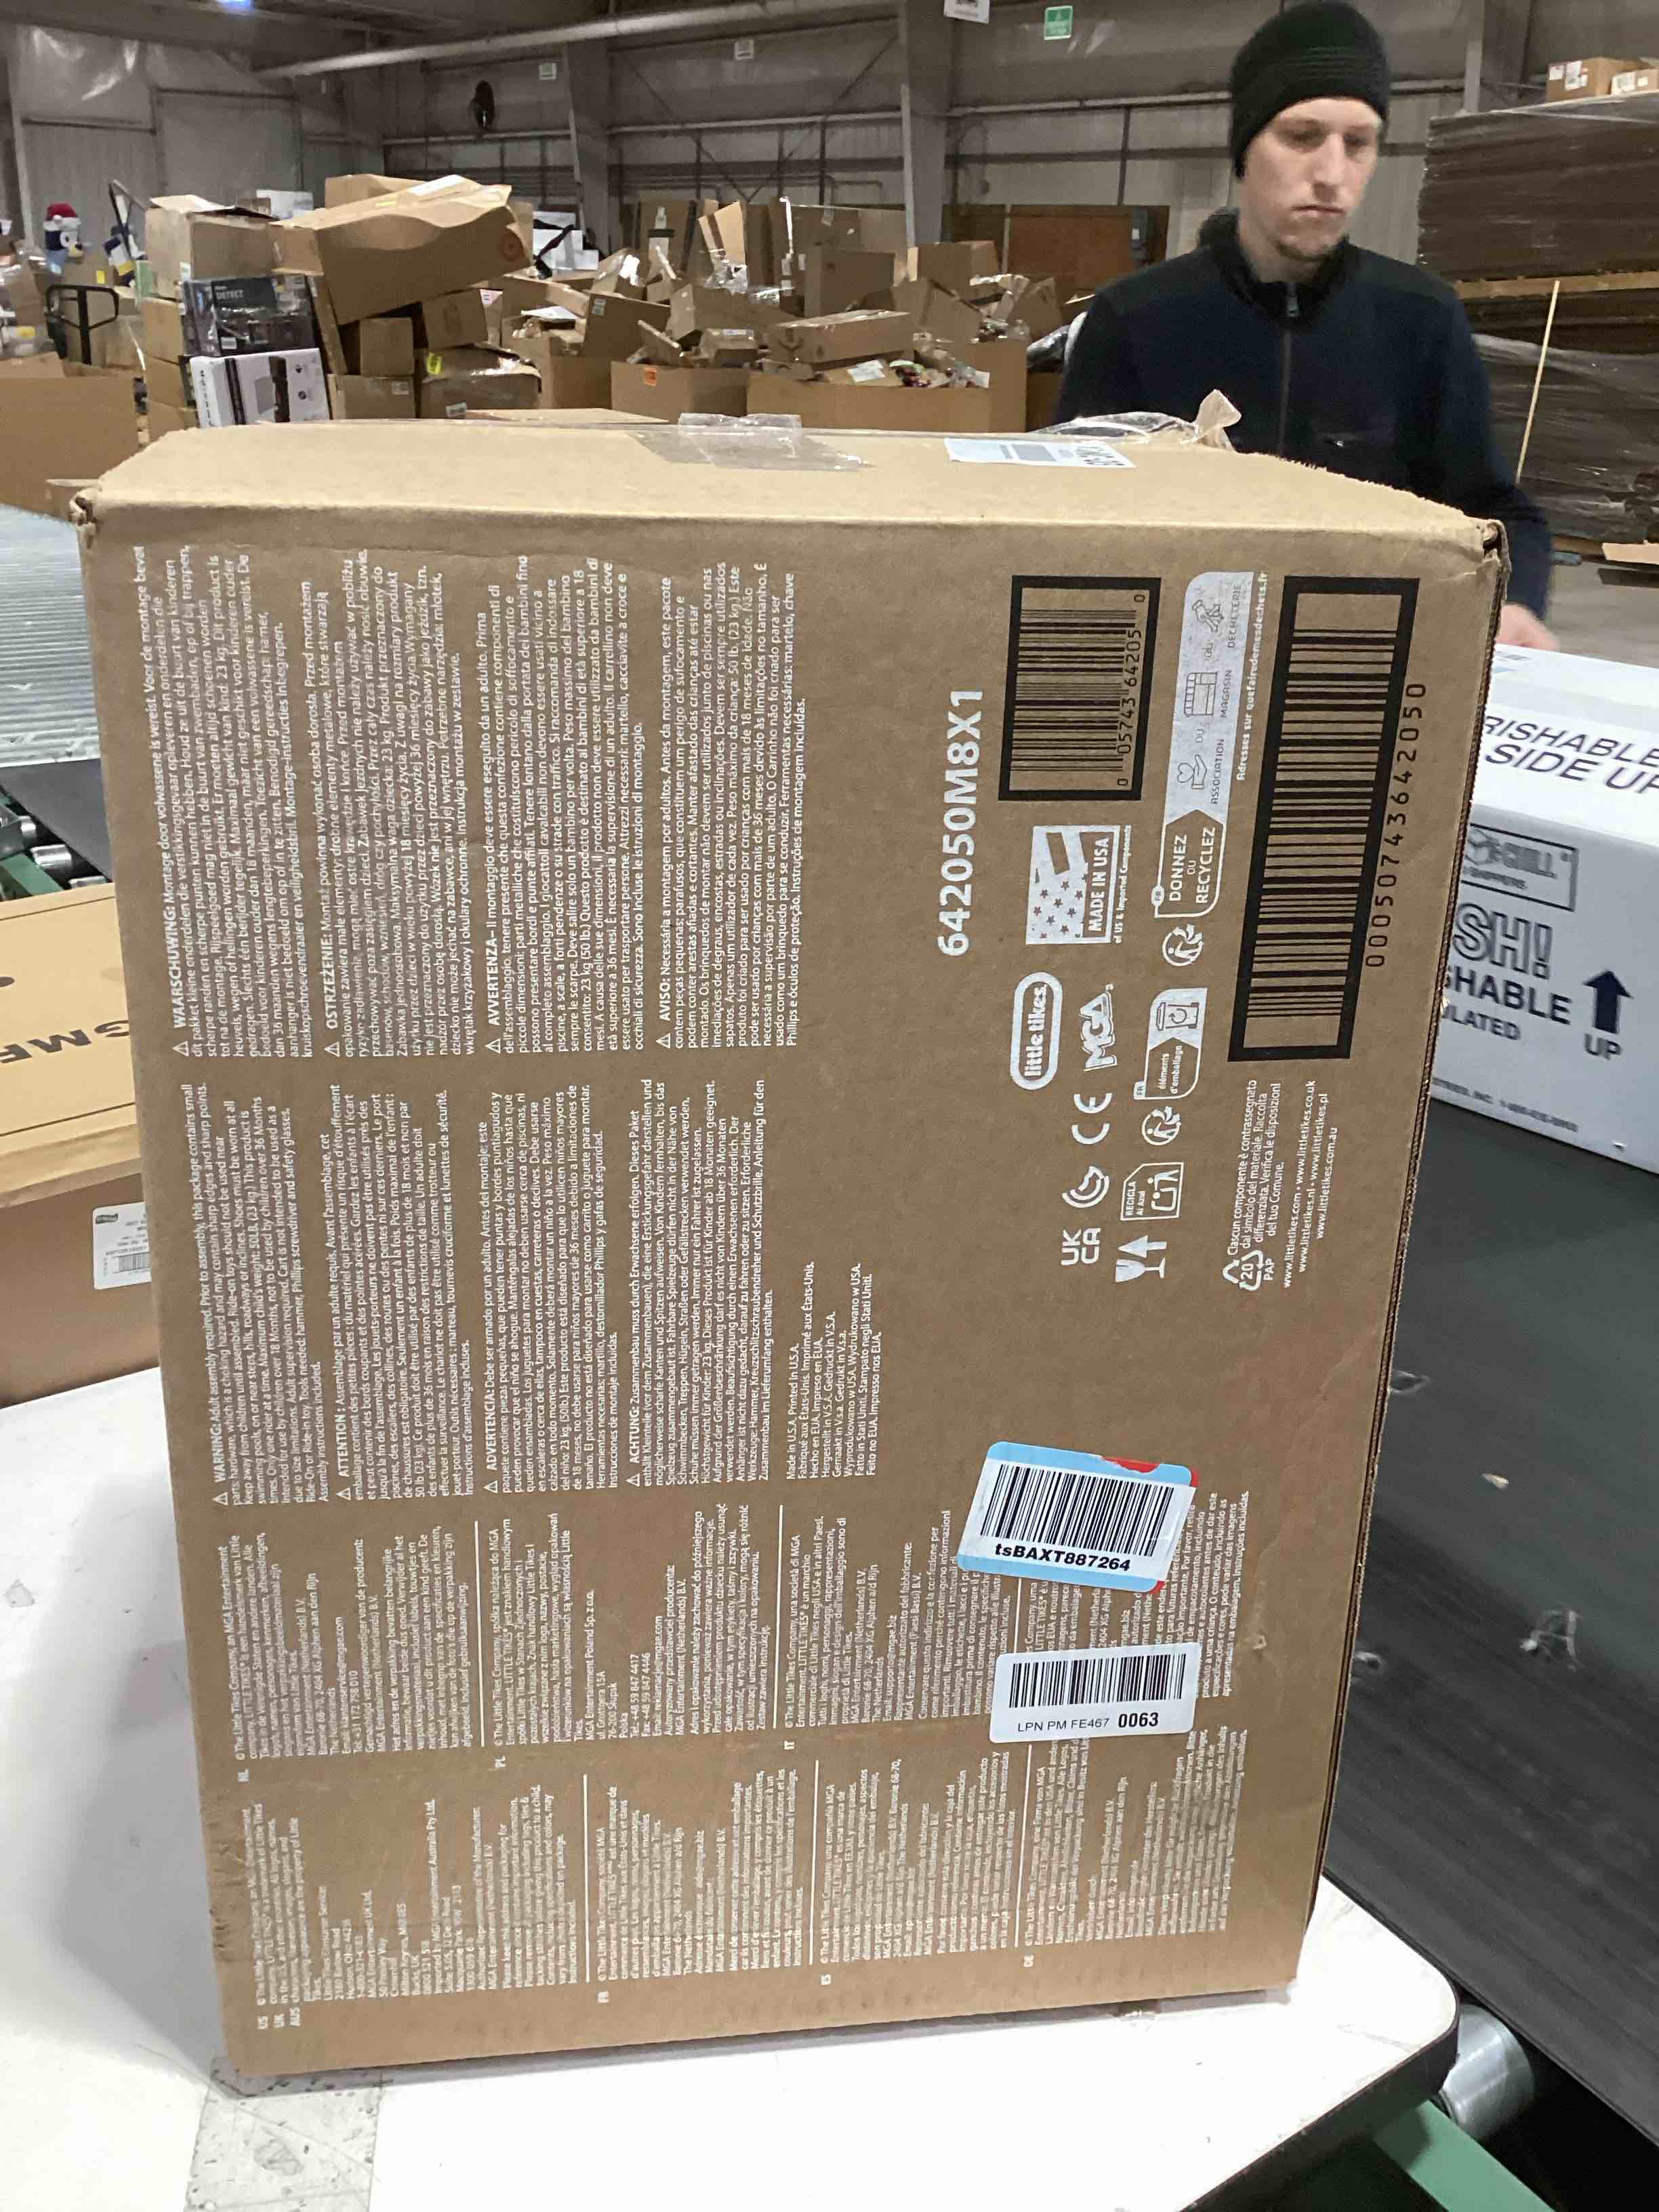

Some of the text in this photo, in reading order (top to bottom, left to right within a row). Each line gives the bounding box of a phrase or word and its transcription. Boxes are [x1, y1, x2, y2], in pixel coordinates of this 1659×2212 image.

[136, 586, 155, 641] montage
[141, 646, 154, 660] de
[1126, 630, 1142, 686] 64205
[142, 664, 157, 692] Voor
[1219, 669, 1232, 718] MAGASIN
[146, 697, 160, 737] vereist.
[1118, 698, 1136, 753] 05743
[149, 740, 161, 749] is
[1485, 743, 1599, 781] SIDE
[150, 752, 167, 819] volwassene
[1210, 738, 1224, 803] ASSOCIATION
[157, 822, 170, 848] door
[937, 691, 983, 956] 642050M8X1
[1120, 824, 1133, 872] Components
[1366, 683, 1427, 967] 00050743642050
[159, 852, 178, 903] Montage
[1088, 837, 1109, 930] MADE IN USA
[1169, 834, 1187, 901] DONNEZ
[1186, 860, 1196, 874] OU
[1195, 827, 1215, 903] RECYCLEZ
[1116, 876, 1129, 910] Imported
[1114, 922, 1123, 933] US
[164, 905, 186, 1027] WAARSCHUWING:
[319, 933, 337, 1028] OSTRZEŻENIE:
[659, 977, 670, 1020] AVISO:
[1078, 991, 1118, 1071] MGA
[1584, 1033, 1622, 1060] UP
[1240, 1080, 1258, 1151] contrassegnato
[1265, 1083, 1283, 1137] disposizioni
[1232, 1161, 1250, 1218] componente
[1241, 1093, 1267, 1248] dal simbolo del materiale. Raccolta
[1261, 1150, 1273, 1183] Verifica
[1282, 1080, 1315, 1287] www.littletikes.com www.littletikes.co.uk
[1297, 1093, 1329, 1272] www.littletikes.nl www.littletikes.pl
[1315, 1127, 1338, 1238] www.littletikes.com.au
[1125, 1181, 1136, 1215] RECICLA
[1254, 1185, 1269, 1242] differenziata.
[1266, 1162, 1284, 1236] del tuo Comune.
[1061, 1228, 1081, 1265] UK
[1081, 1227, 1101, 1264] CA
[1229, 1221, 1241, 1254] Ciascun
[182, 1084, 225, 1481] WARNING: Adult assembly required. Prior to assembly, this package contains small
[800, 1261, 813, 1311] États-Unis.
[851, 1263, 860, 1285] USA.
[853, 1287, 859, 1295] w
[1240, 1263, 1254, 1279] 20
[1263, 1258, 1275, 1280] PAP
[801, 1331, 813, 1370] Imprimé
[848, 1298, 861, 1365] Wydrukowano
[871, 1331, 880, 1353] EUA.
[798, 1374, 810, 1420] États-Unis.
[846, 1367, 856, 1388] USA.
[855, 1274, 872, 1475] Fatto in Stati Uniti. Stampato negli Stati Uniti.
[868, 1374, 880, 1414] Impresso
[310, 1361, 331, 1501] Assembly instructions included.
[484, 1389, 497, 1470] ADVERTENCIA:
[786, 1343, 798, 1479] Made in U.S.A. Printed in U.S.A.
[810, 1337, 823, 1478] Hecho en EUA. Impreso en EUA.
[867, 1417, 877, 1437] EUA.
[335, 1414, 349, 1476] ATTENTION
[629, 1406, 640, 1463] ACHTUNG:
[798, 1440, 810, 1478] Fabriqué
[843, 1400, 857, 1476] Wyprodukowano
[869, 1439, 876, 1451] no
[865, 1453, 875, 1475] Feito
[996, 1544, 1130, 1572] tsBAXT887264
[784, 1740, 794, 1749] IT
[1017, 1713, 1159, 1733] LPN PM FE467 0063
[495, 1757, 505, 1767] PL
